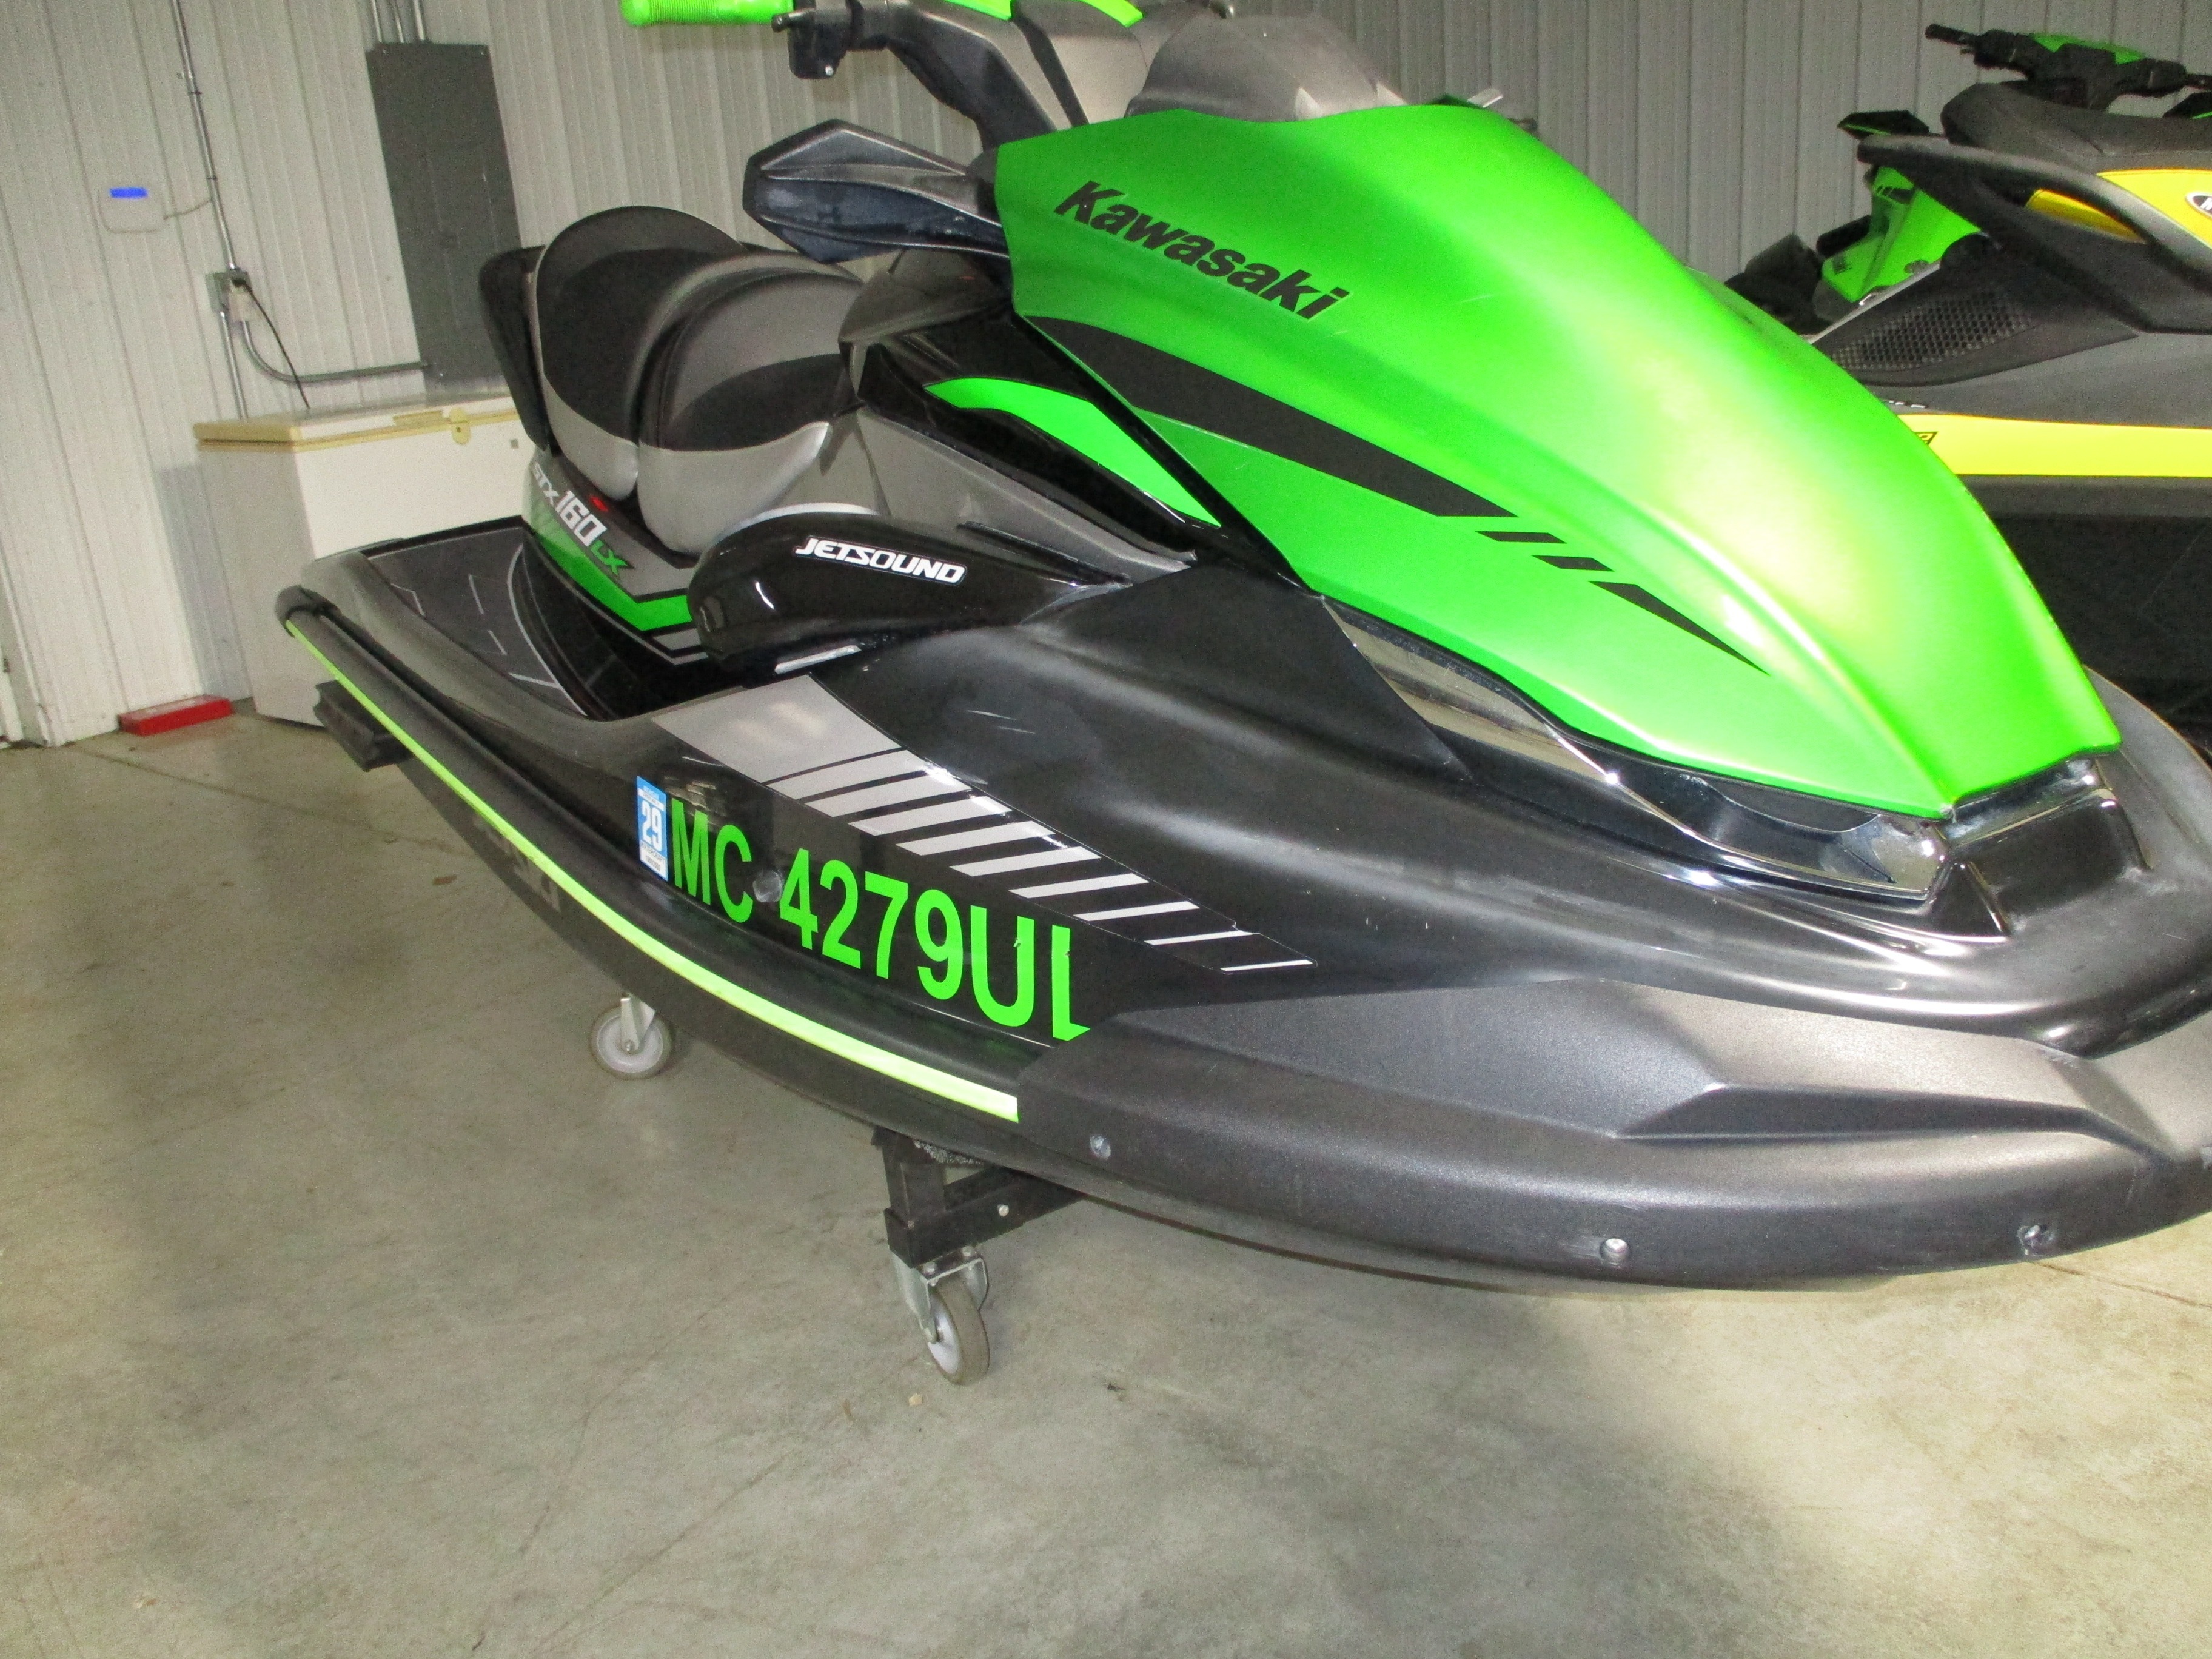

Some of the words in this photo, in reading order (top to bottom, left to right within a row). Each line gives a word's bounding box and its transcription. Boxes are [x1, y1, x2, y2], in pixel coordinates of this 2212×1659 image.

[1054, 180, 1350, 320] Kawasaki
[555, 490, 608, 548] 160
[590, 540, 628, 575] LX
[795, 538, 965, 583] JETSOUND
[642, 800, 663, 851] 29
[671, 799, 754, 923] MC
[779, 848, 1090, 1041] 4279UL
